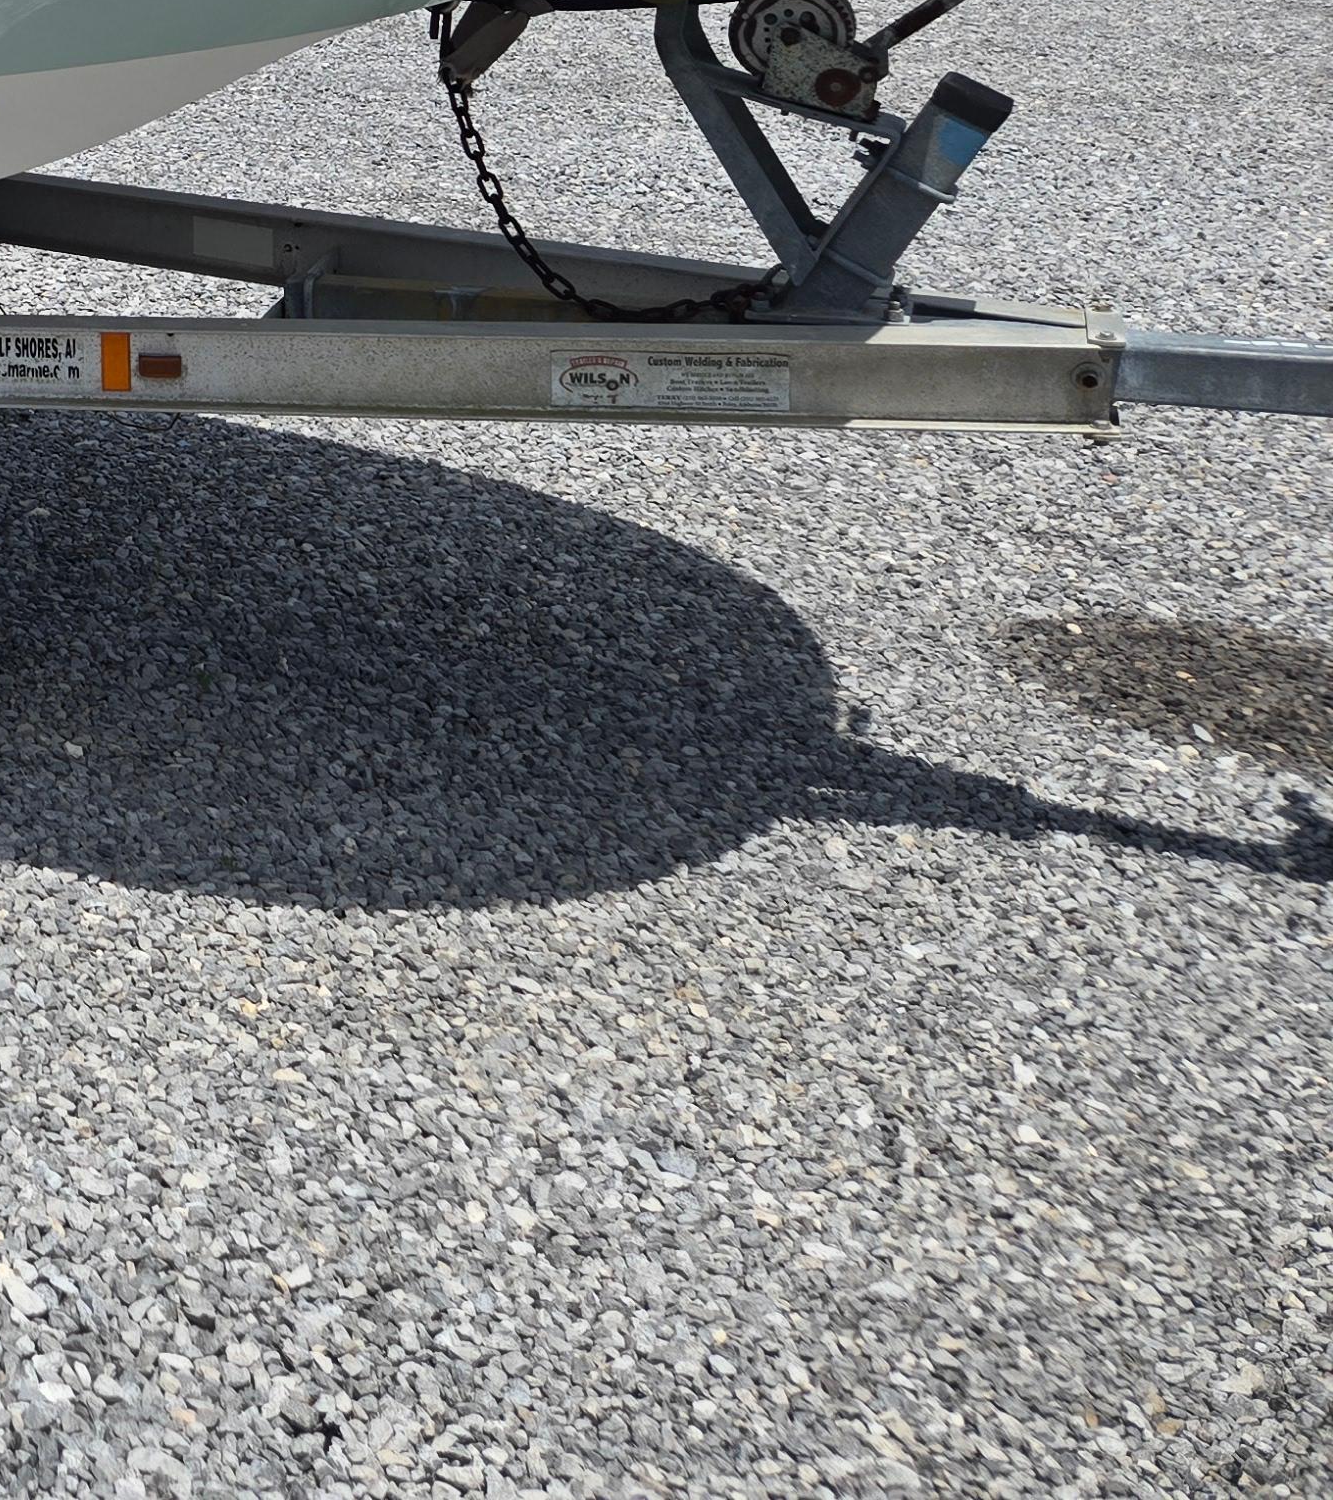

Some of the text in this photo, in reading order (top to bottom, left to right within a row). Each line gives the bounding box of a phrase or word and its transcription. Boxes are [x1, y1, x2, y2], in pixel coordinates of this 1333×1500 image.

[647, 355, 789, 370] Custom Welding & Fabrication
[569, 372, 630, 391] WILSON
